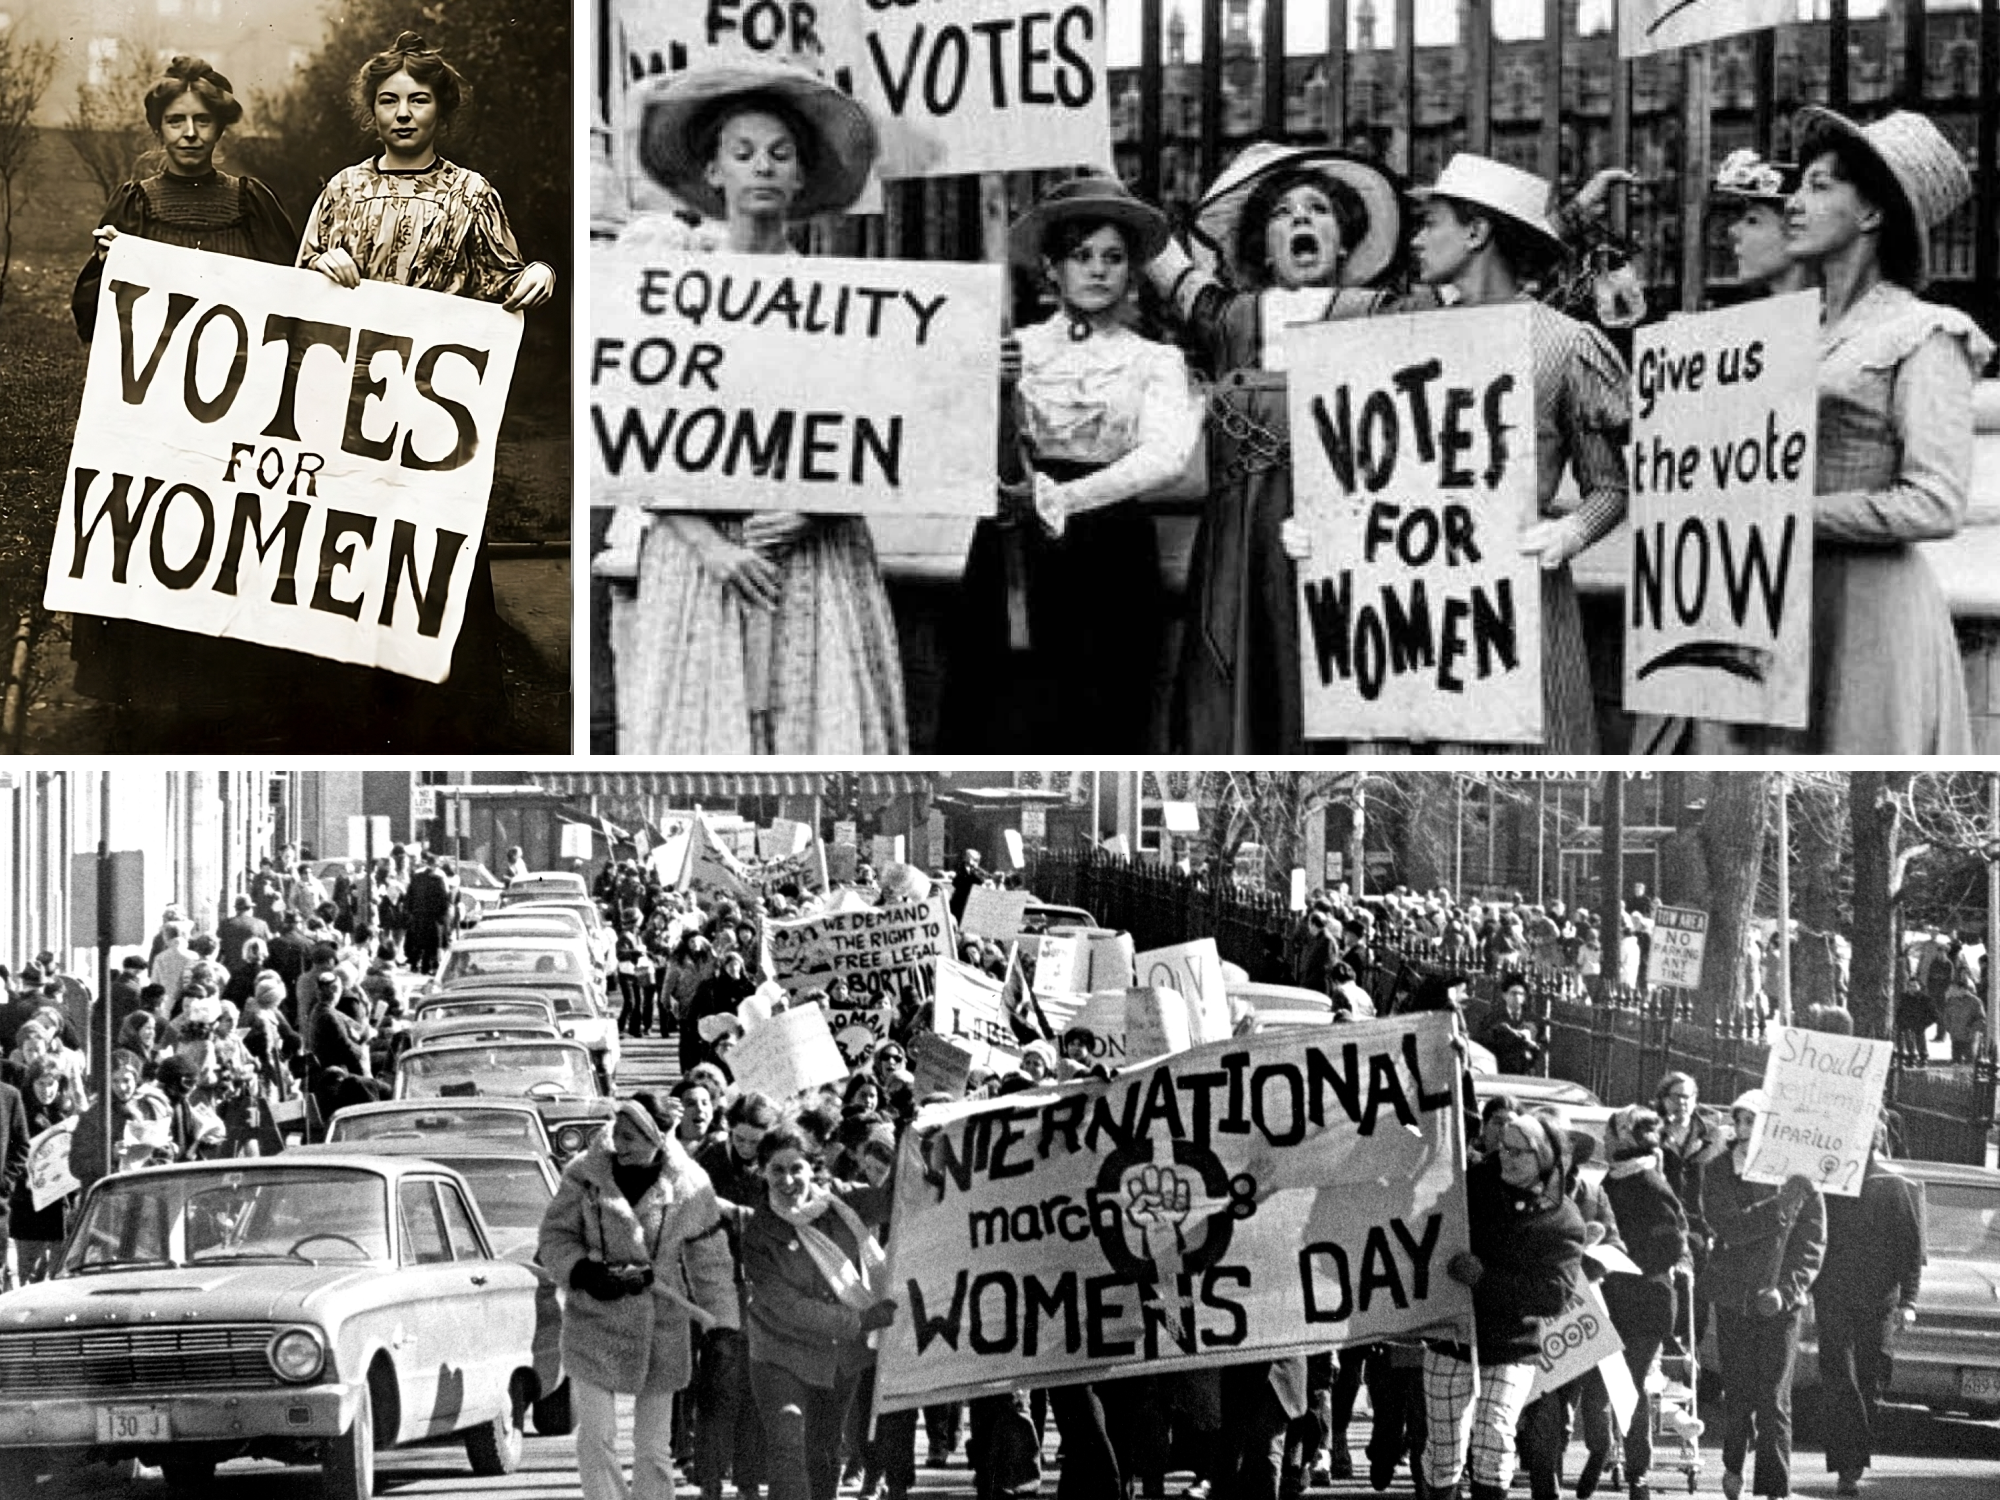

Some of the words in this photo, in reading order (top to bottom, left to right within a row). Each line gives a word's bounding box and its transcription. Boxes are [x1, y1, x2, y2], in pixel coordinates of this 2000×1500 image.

[706, 0, 824, 53] FOR
[866, 5, 1096, 116] VOTES
[637, 268, 948, 346] EQUALITY
[109, 279, 490, 472] VOTES
[590, 337, 723, 390] FOR
[1716, 340, 1765, 387] us
[590, 405, 903, 488] WOMEN
[1312, 358, 1518, 496] VOTES
[1634, 435, 1698, 496] the
[1712, 408, 1807, 490] vote
[222, 442, 325, 498] FOR
[68, 466, 468, 640] WOMEN
[1365, 502, 1482, 567] FOR
[1632, 513, 1796, 640] NOW
[1304, 569, 1519, 701] WOMEN
[823, 915, 846, 931] WE
[852, 903, 930, 929] DEMAND
[831, 935, 866, 951] THE
[870, 927, 917, 948] RIGHT
[922, 923, 940, 938] TO
[1666, 930, 1691, 946] NO
[834, 951, 882, 970] FREE
[1661, 967, 1688, 982] TIME
[1662, 957, 1687, 969] ANY
[1779, 1029, 1875, 1079] Should
[1229, 1172, 1258, 1220] 8
[907, 1265, 1251, 1360] WOMENS
[1299, 1213, 1443, 1325] DAY
